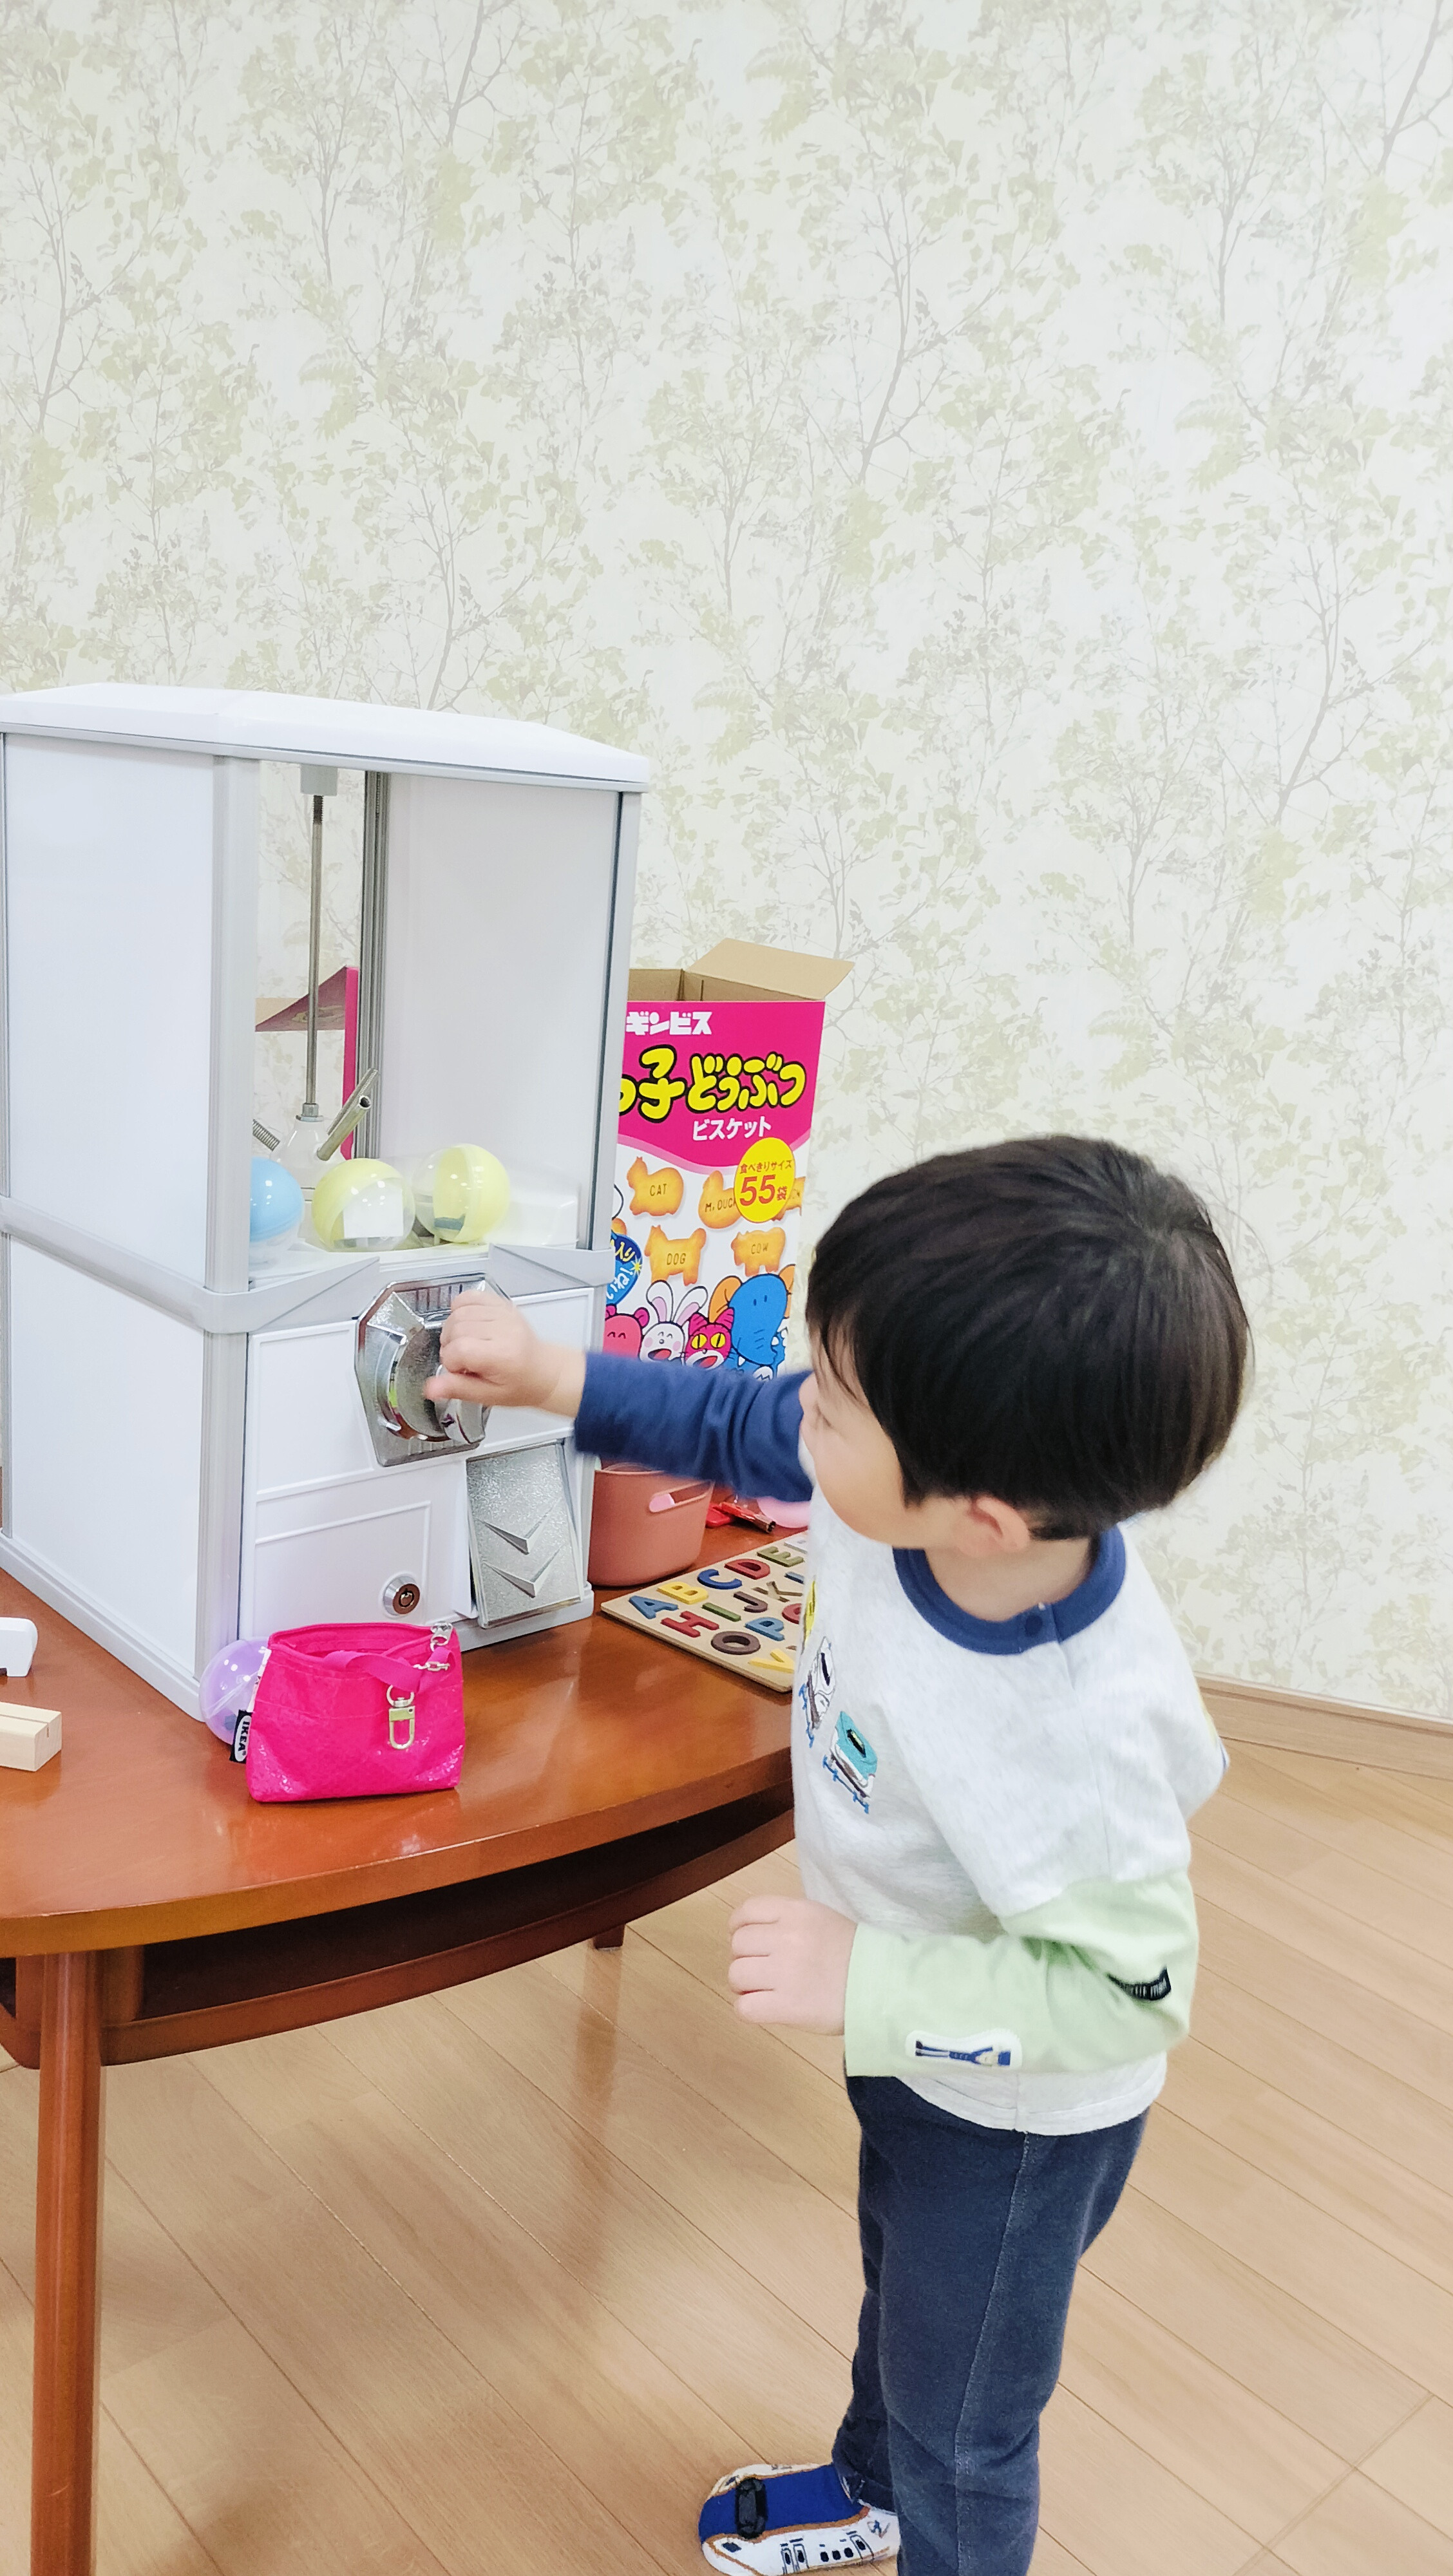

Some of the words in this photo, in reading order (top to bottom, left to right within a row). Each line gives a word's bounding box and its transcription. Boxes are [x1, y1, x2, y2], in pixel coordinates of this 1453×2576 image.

[625, 1011, 712, 1036] ギンビス
[692, 1116, 772, 1141] ビスケット
[739, 1160, 792, 1174] 食べきりサイズ
[649, 1184, 667, 1197] CAT
[739, 1175, 788, 1206] 55袋
[751, 1243, 768, 1254] COW
[667, 1253, 687, 1265] DOG
